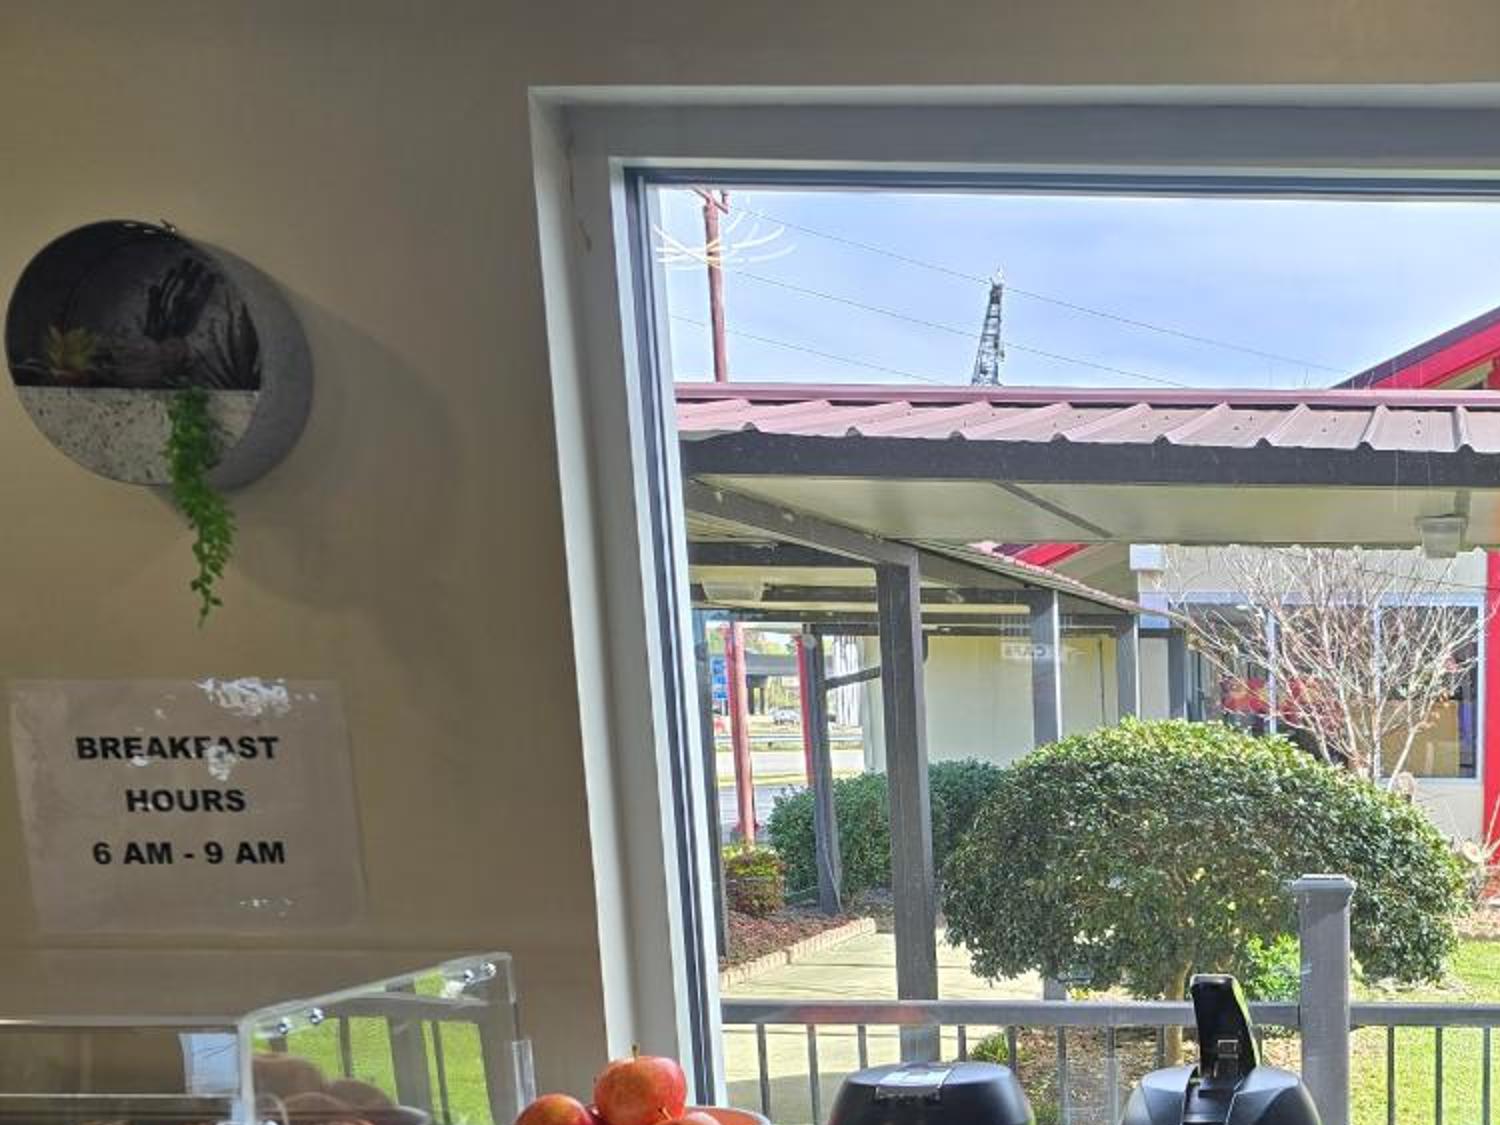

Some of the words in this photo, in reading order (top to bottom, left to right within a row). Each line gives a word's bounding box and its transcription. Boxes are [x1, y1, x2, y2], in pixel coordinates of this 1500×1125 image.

[75, 735, 279, 761] BREAKFAST
[124, 788, 247, 813] HOURS
[92, 842, 112, 865] 6
[123, 841, 174, 865] AM
[203, 841, 224, 865] 9
[235, 840, 286, 865] AM
